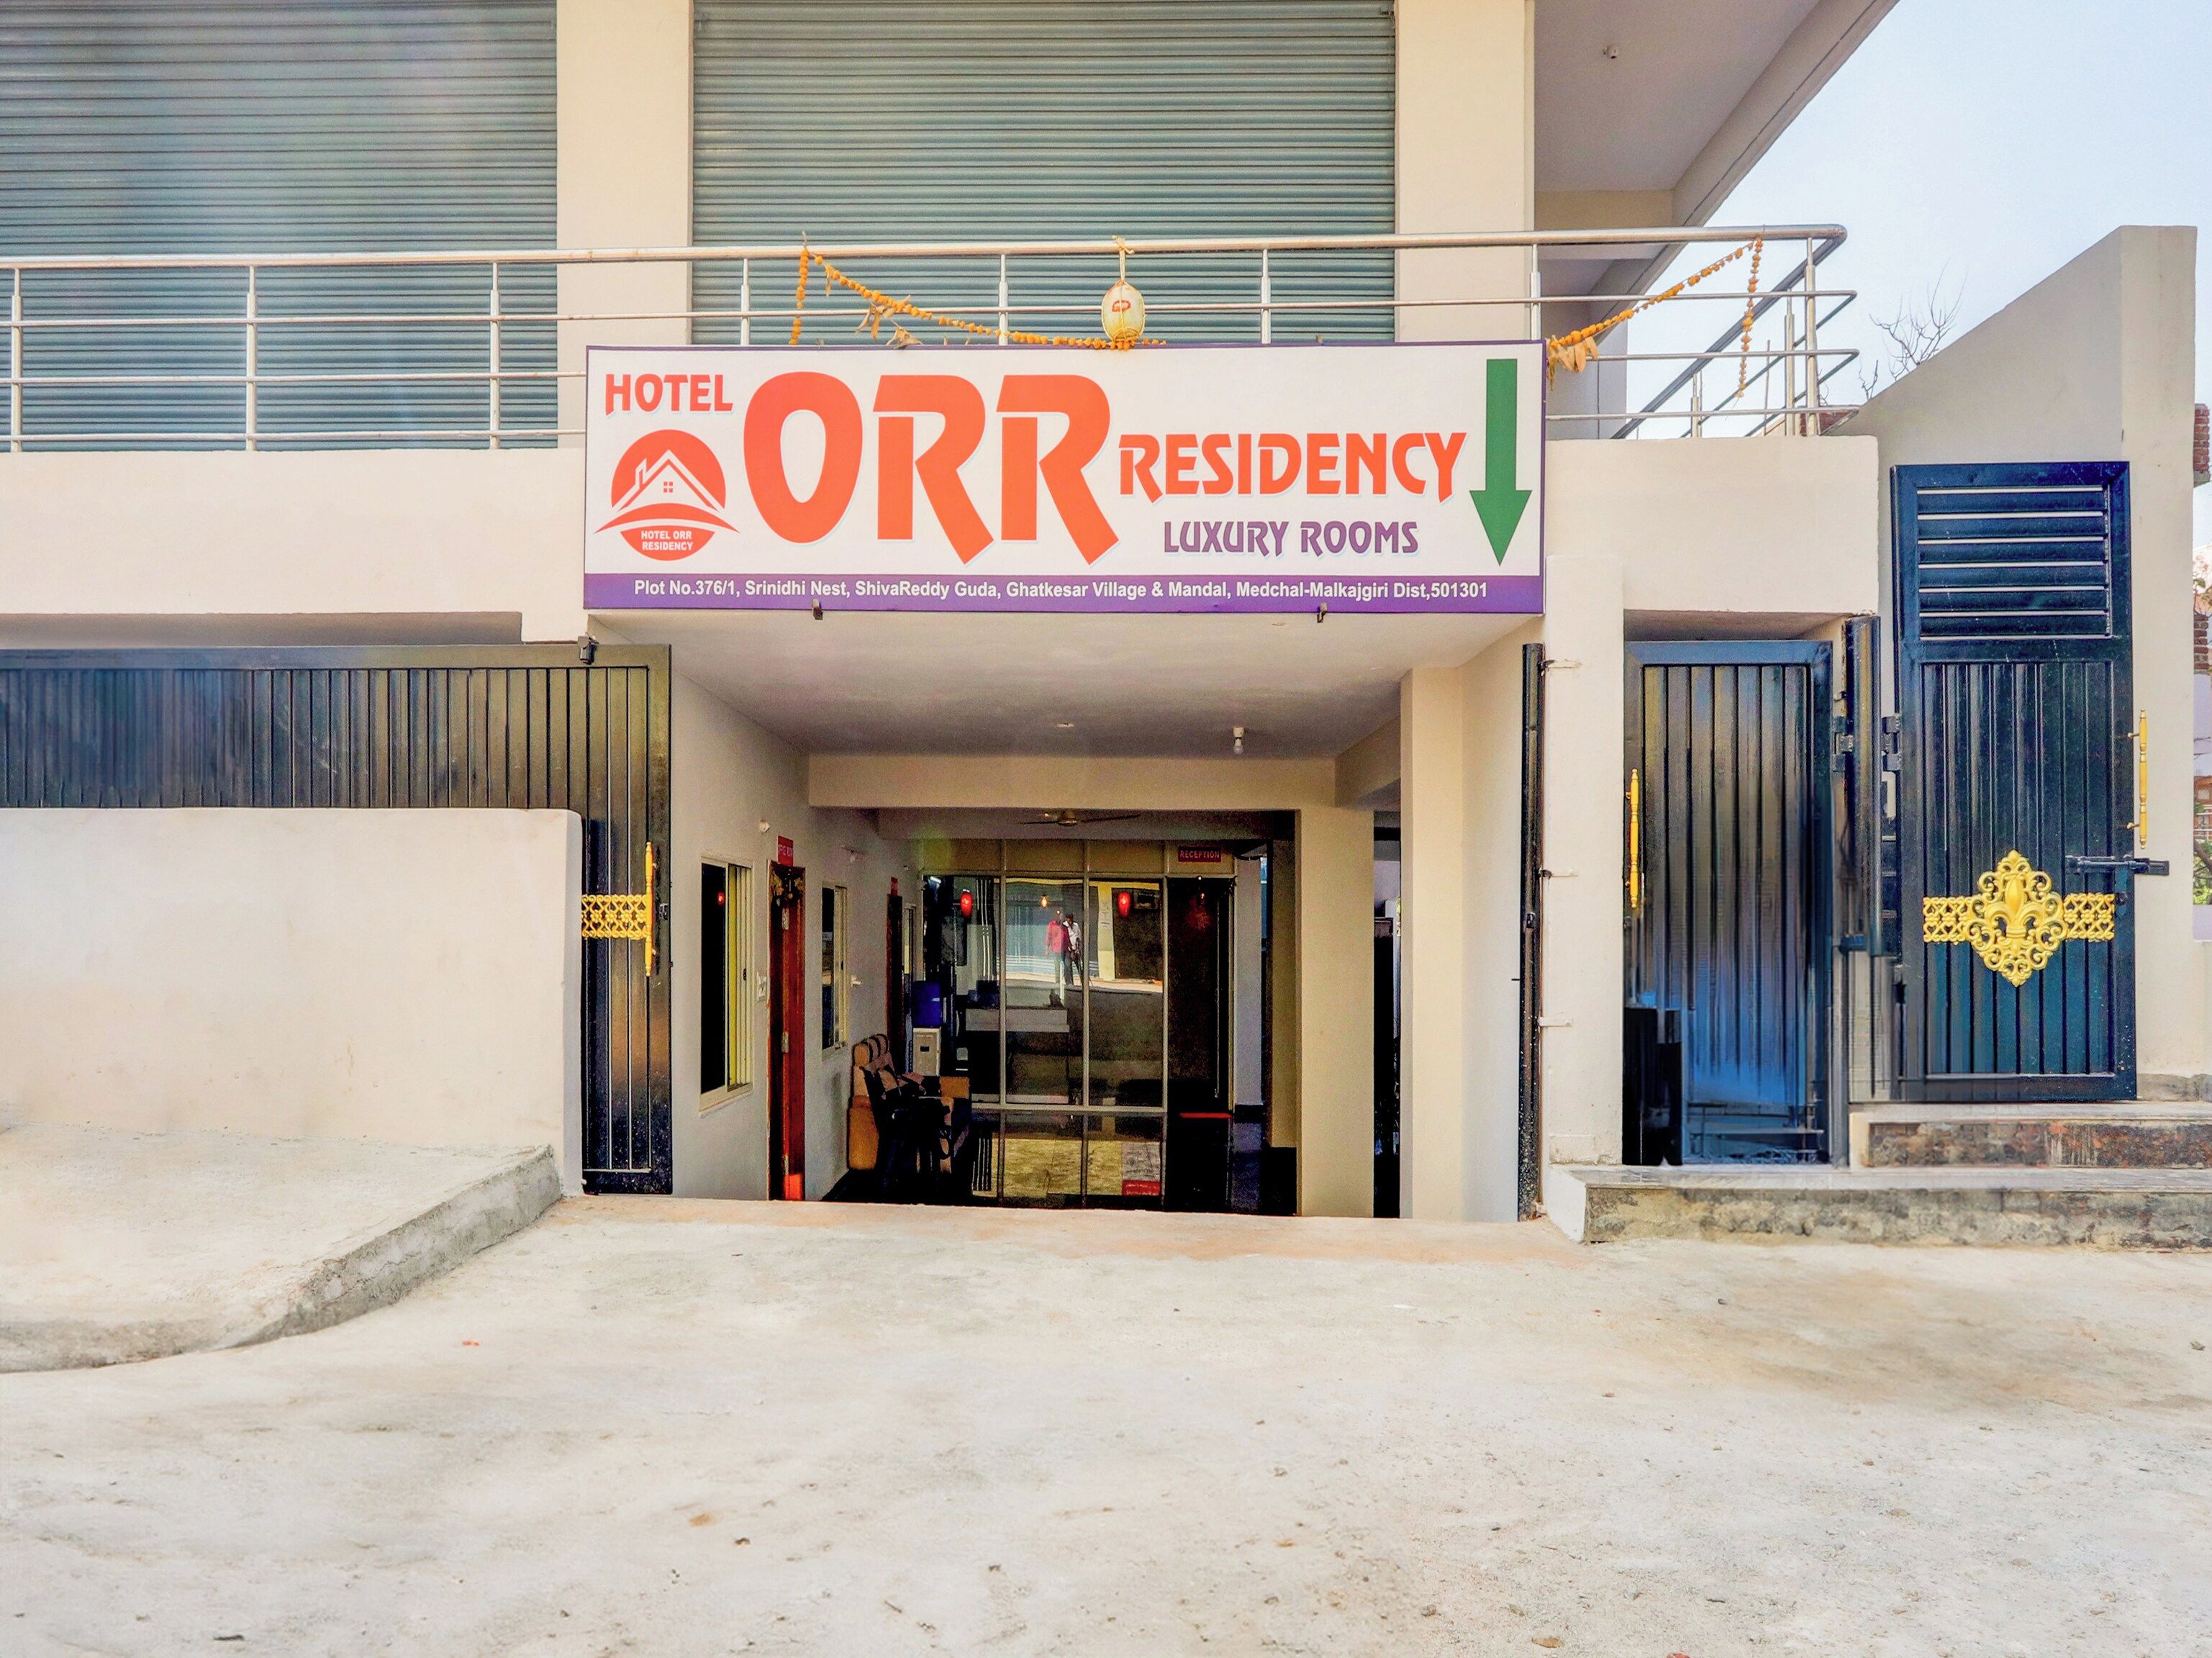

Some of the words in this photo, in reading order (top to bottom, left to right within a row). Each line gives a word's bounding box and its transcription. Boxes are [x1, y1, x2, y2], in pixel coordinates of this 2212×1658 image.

[605, 373, 734, 416] HOTEL
[743, 371, 1119, 566] ORR
[1118, 432, 1467, 503] RESIDENCY
[640, 530, 671, 540] HOTEL
[673, 530, 692, 540] ORR
[1164, 520, 1289, 557] LUXURY
[1300, 520, 1419, 557] ROOMS
[642, 542, 694, 551] RESIDENCY
[634, 579, 665, 595] Plot
[668, 579, 740, 597] No.376/1,
[745, 579, 806, 596] Srinidhi
[810, 580, 851, 598] Nest,
[855, 580, 950, 599] ShivaReddy
[954, 581, 1002, 599] Guda,
[1006, 581, 1088, 597] Ghatkesar
[1092, 581, 1146, 601] Village
[1151, 581, 1164, 597] &
[1168, 581, 1231, 599] Mandal,
[1236, 581, 1390, 601] Medchal-Malkajgiri
[1393, 581, 1487, 599] Dist,501301
[1180, 850, 1220, 859] RECEPTION
